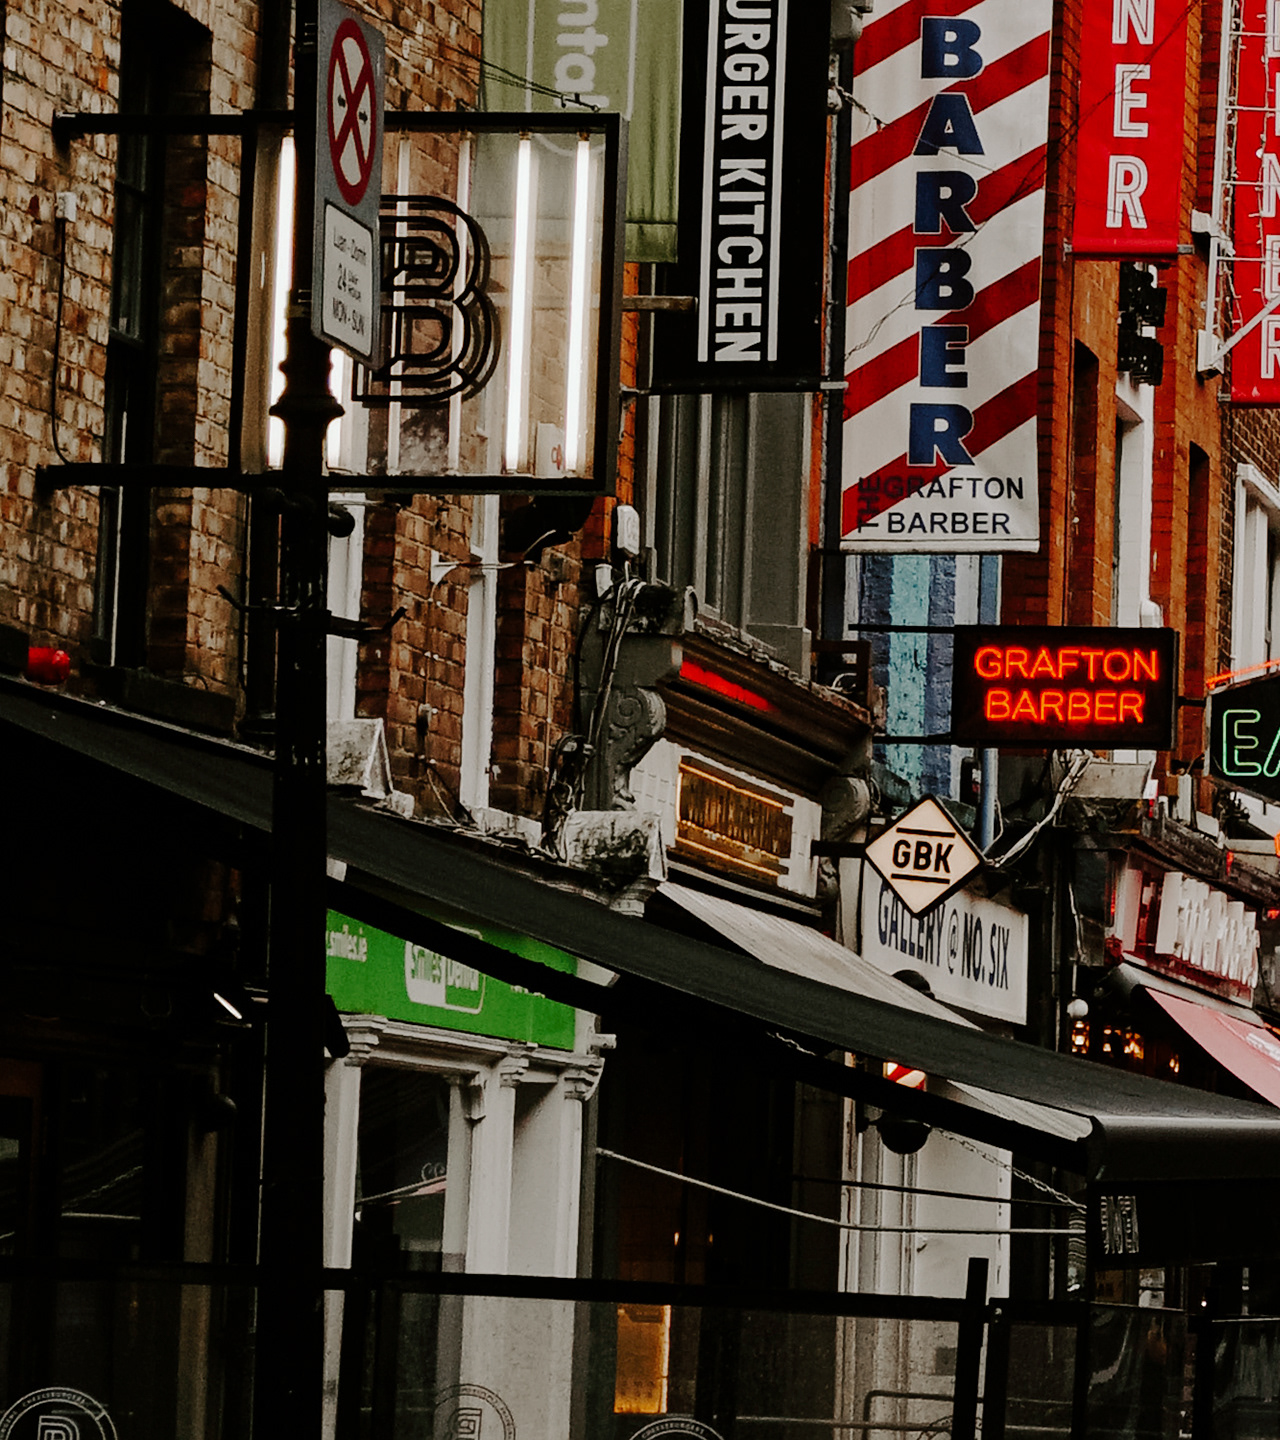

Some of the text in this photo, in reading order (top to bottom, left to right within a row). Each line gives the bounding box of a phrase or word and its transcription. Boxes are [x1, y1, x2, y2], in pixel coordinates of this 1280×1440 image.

[907, 17, 984, 467] BARBER
[714, 157, 767, 364] KITCHEN
[884, 477, 1025, 501] GRAFTON
[887, 511, 1011, 535] BARBER
[974, 648, 1160, 682] GRAFTON
[985, 690, 1145, 724] BARBER
[892, 839, 955, 874] GBK
[877, 880, 946, 967] GALLERY
[961, 911, 986, 984] NO.
[988, 922, 1011, 990] SIX
